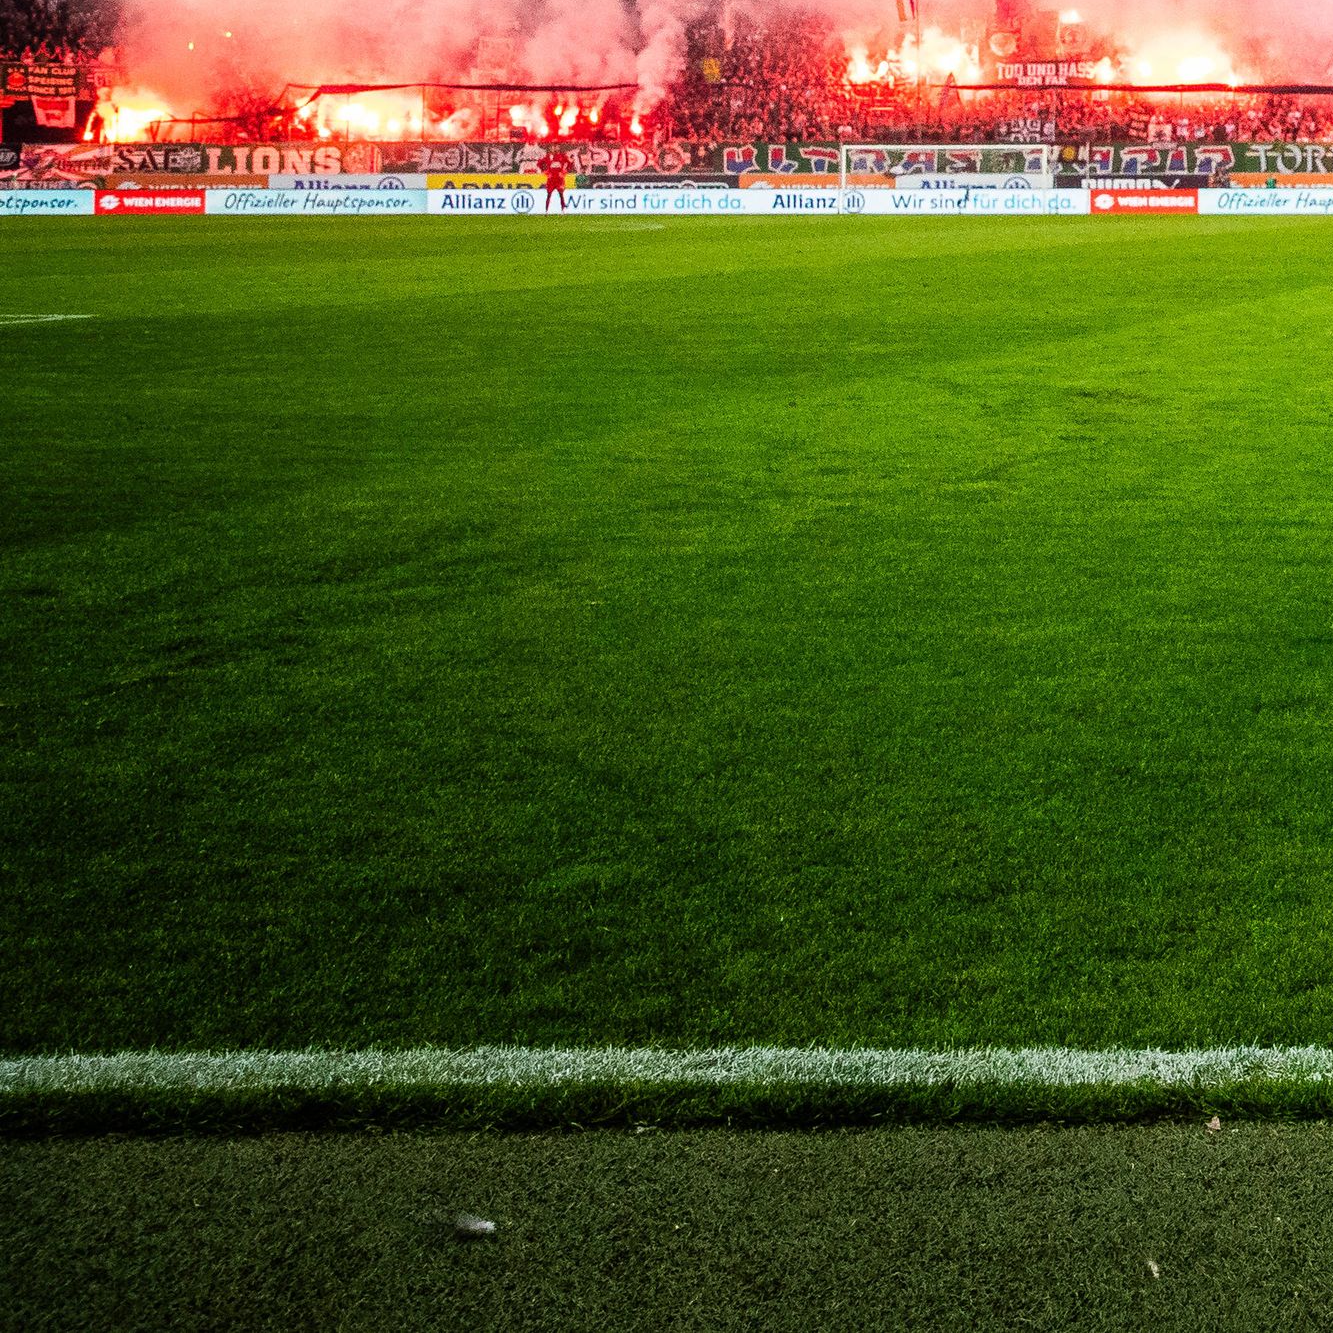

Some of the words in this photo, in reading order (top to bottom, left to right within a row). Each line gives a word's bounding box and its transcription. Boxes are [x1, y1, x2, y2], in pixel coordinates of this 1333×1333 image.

[51, 68, 77, 76] CLUB
[1027, 64, 1056, 77] UND
[1059, 62, 1098, 79] HASS
[206, 146, 342, 175] LIONS
[124, 197, 152, 207] WIEN
[154, 197, 201, 207] ENERGIE
[224, 193, 298, 209] Offizieller
[303, 193, 413, 212] Hauptsponsor.
[441, 194, 505, 209] Allianz
[566, 195, 594, 209] Wir
[600, 194, 637, 209] sind
[643, 194, 668, 209] für
[673, 194, 711, 209] dich
[717, 194, 746, 209] da.
[772, 194, 836, 209] Allianz
[892, 194, 924, 209] Wir
[930, 194, 967, 209] sind
[973, 194, 998, 209] für
[1004, 194, 1041, 209] dich
[1047, 194, 1077, 210] da.
[1149, 197, 1196, 207] ENERGIE
[1217, 192, 1289, 209] Offizieller
